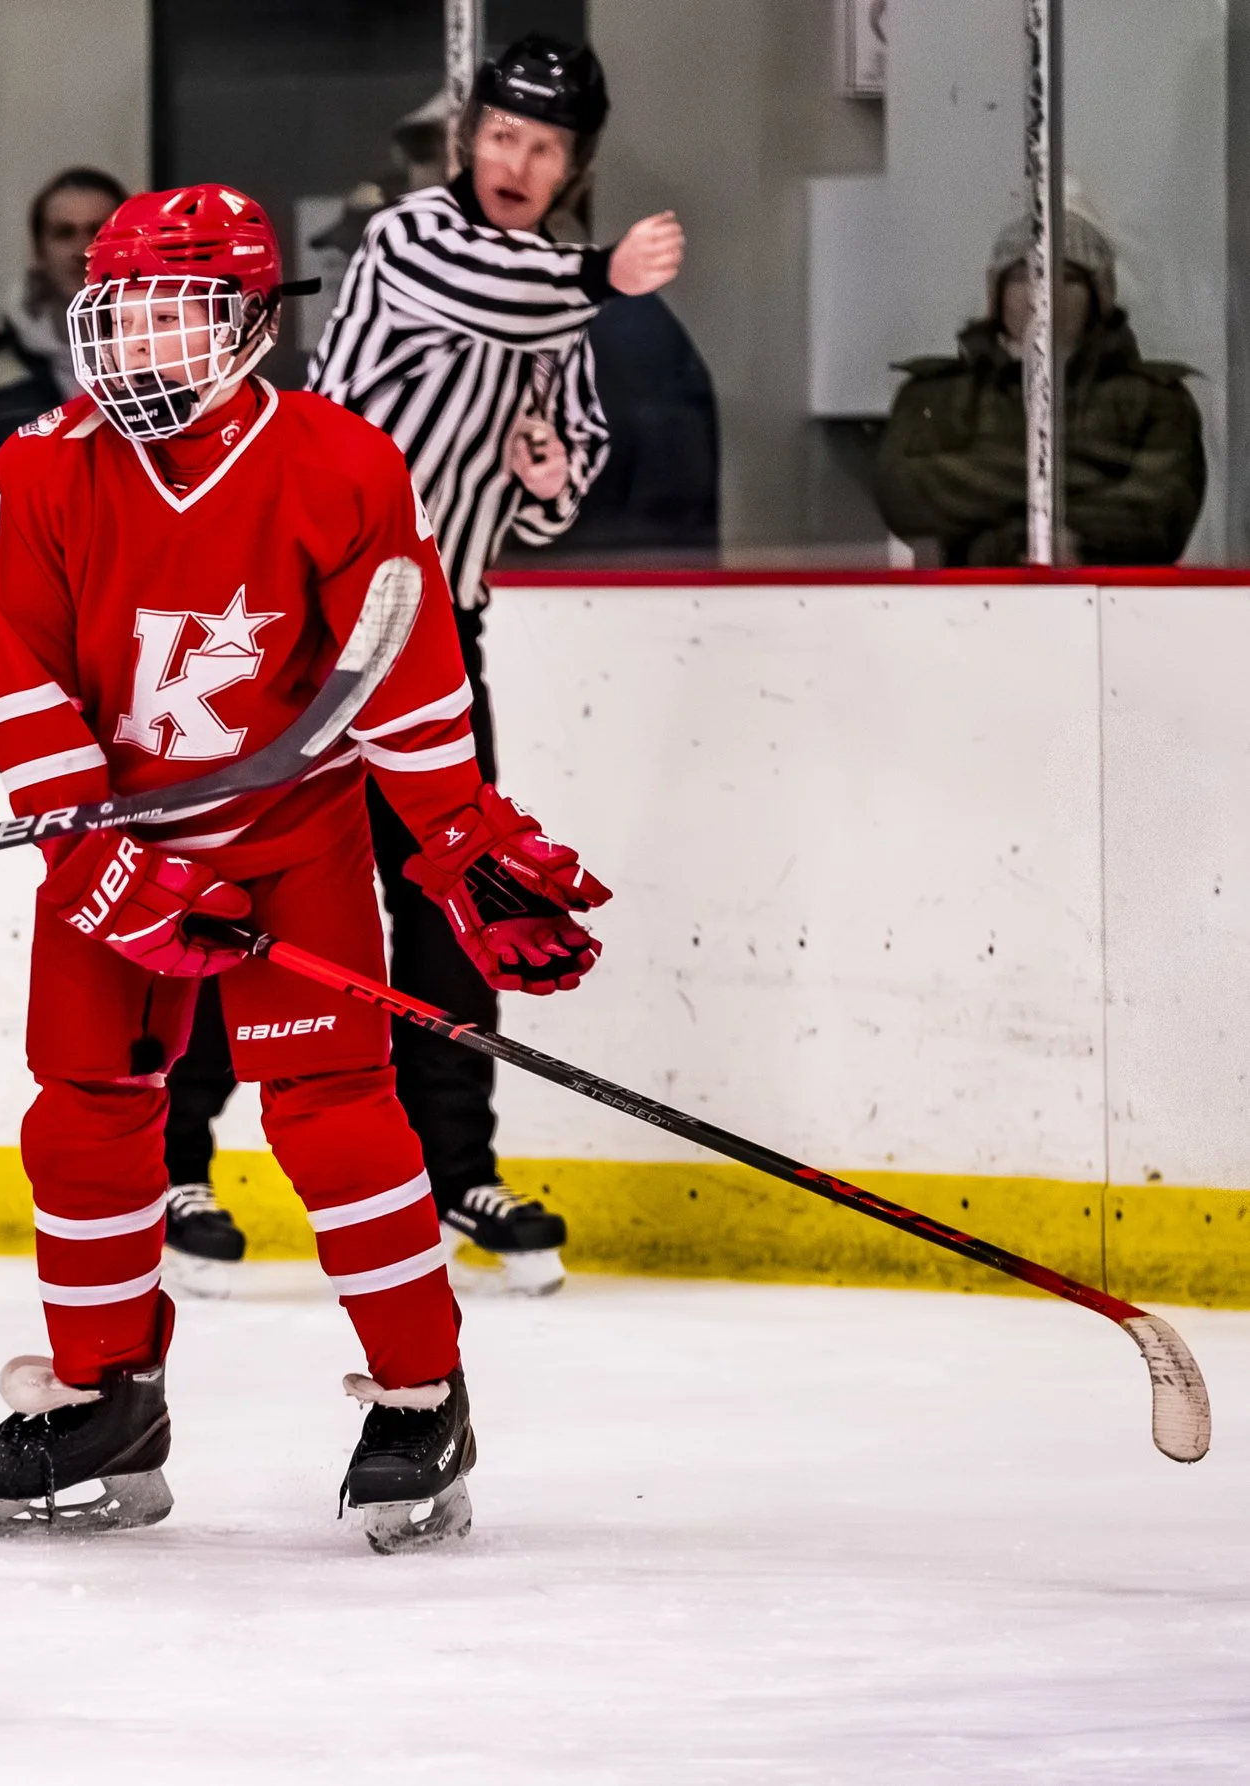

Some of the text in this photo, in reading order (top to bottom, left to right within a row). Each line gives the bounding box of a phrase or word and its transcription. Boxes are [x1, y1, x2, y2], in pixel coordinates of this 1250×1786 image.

[65, 836, 144, 934] AUER
[236, 1015, 337, 1041] BAUER
[563, 1078, 662, 1125] JETSPEED
